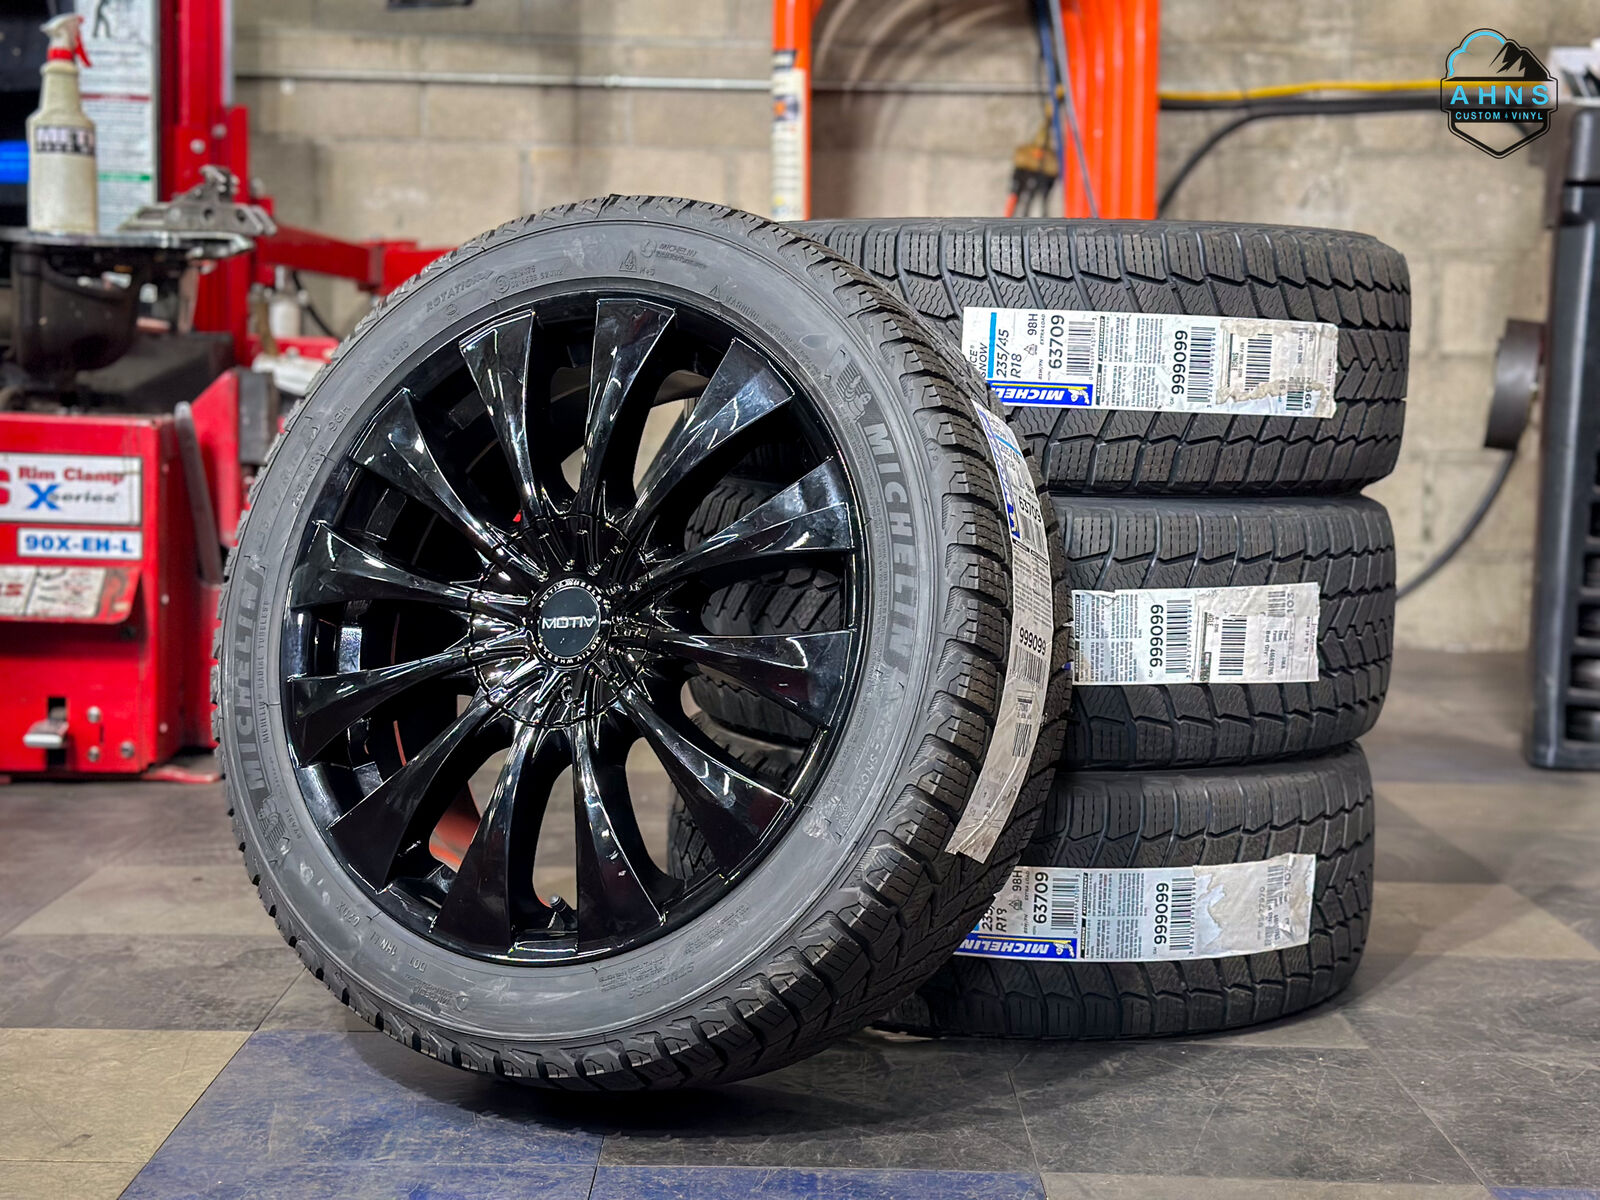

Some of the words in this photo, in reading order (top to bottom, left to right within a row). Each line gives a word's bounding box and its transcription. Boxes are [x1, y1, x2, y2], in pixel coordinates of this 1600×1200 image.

[1027, 313, 1039, 336] 98H
[996, 328, 1009, 379] 235/45
[1049, 314, 1065, 369] 63709
[1010, 353, 1022, 379] R18
[1171, 330, 1188, 395] 999099
[990, 387, 1065, 401] MICHEL
[18, 467, 55, 479] Rim
[63, 467, 126, 484] Clamp
[1018, 495, 1042, 523] 63709
[25, 535, 133, 553] 90X-EH-L
[863, 422, 917, 658] MICHELIN
[542, 615, 597, 629] MOTIV
[1149, 604, 1164, 668] 999099
[1019, 626, 1046, 656] 999099
[234, 564, 269, 791] MICHELIN
[1012, 870, 1023, 892] 98H
[1033, 872, 1049, 924] 63709
[1154, 882, 1169, 945] 999099
[959, 938, 1050, 954] MICHELIN
